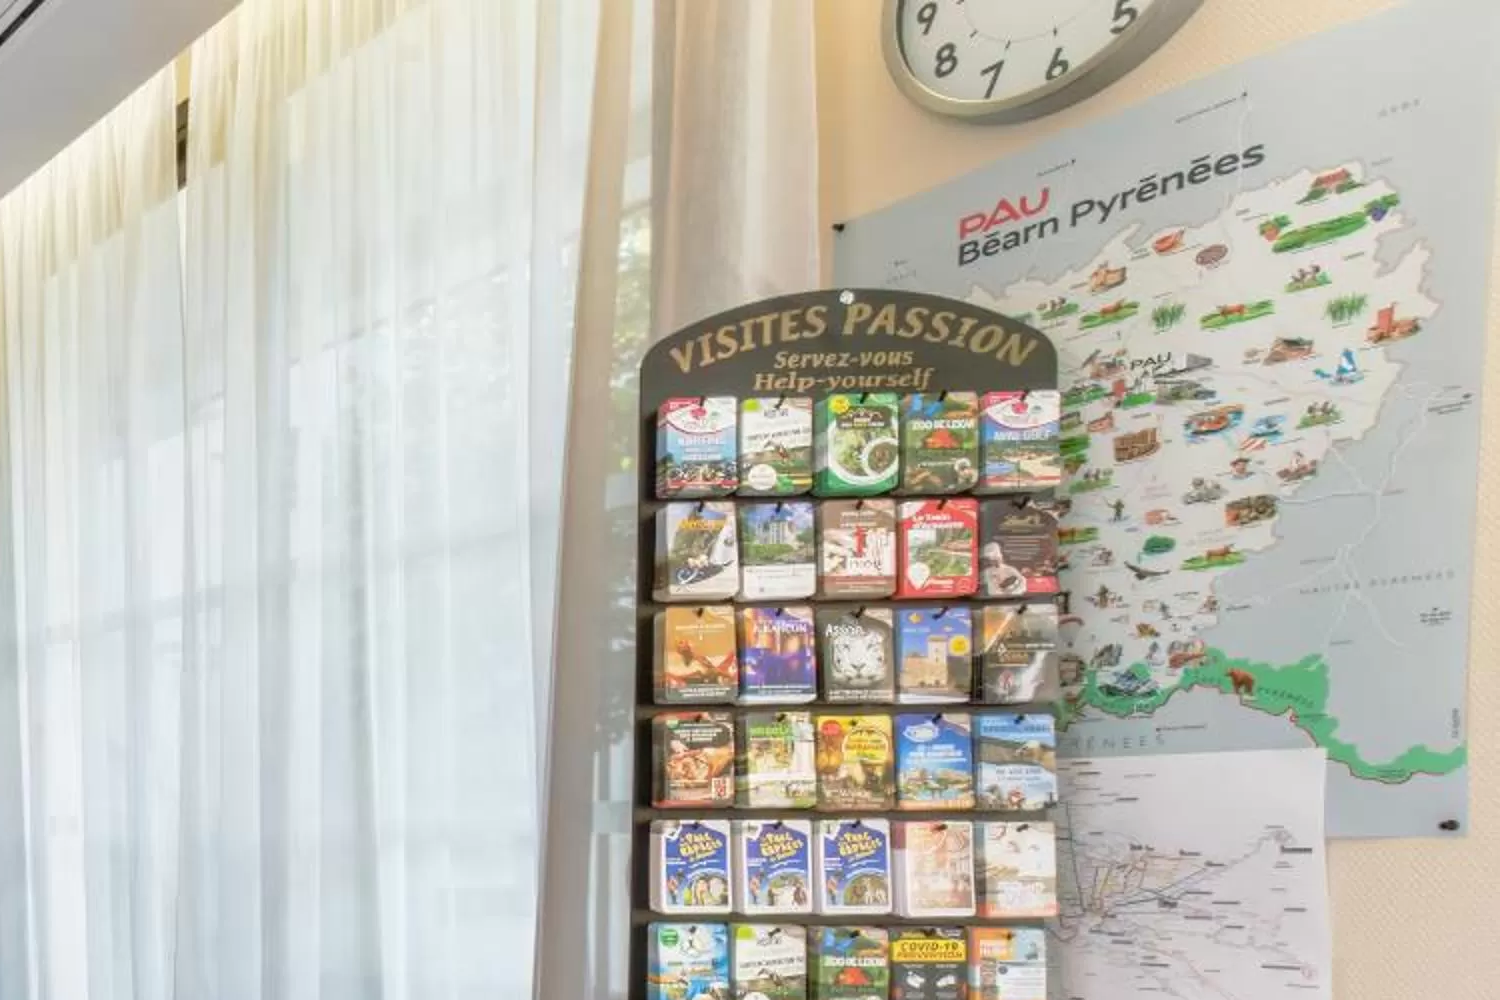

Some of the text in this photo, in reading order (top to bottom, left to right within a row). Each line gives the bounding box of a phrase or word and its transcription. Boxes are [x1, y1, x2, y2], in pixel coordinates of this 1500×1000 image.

[916, 2, 938, 36] 9
[1110, 0, 1138, 35] 5
[934, 42, 959, 79] 8
[1045, 47, 1070, 81] 6
[980, 59, 1006, 99] 7
[958, 143, 1266, 267] Béarn Pyrénées
[958, 187, 1050, 241] PAU
[669, 302, 1039, 374] VISITES PASSION
[773, 350, 915, 370] Servez-vous
[1130, 351, 1173, 370] PAU
[752, 366, 935, 393] Help-yourself
[899, 942, 959, 952] COVID-19
